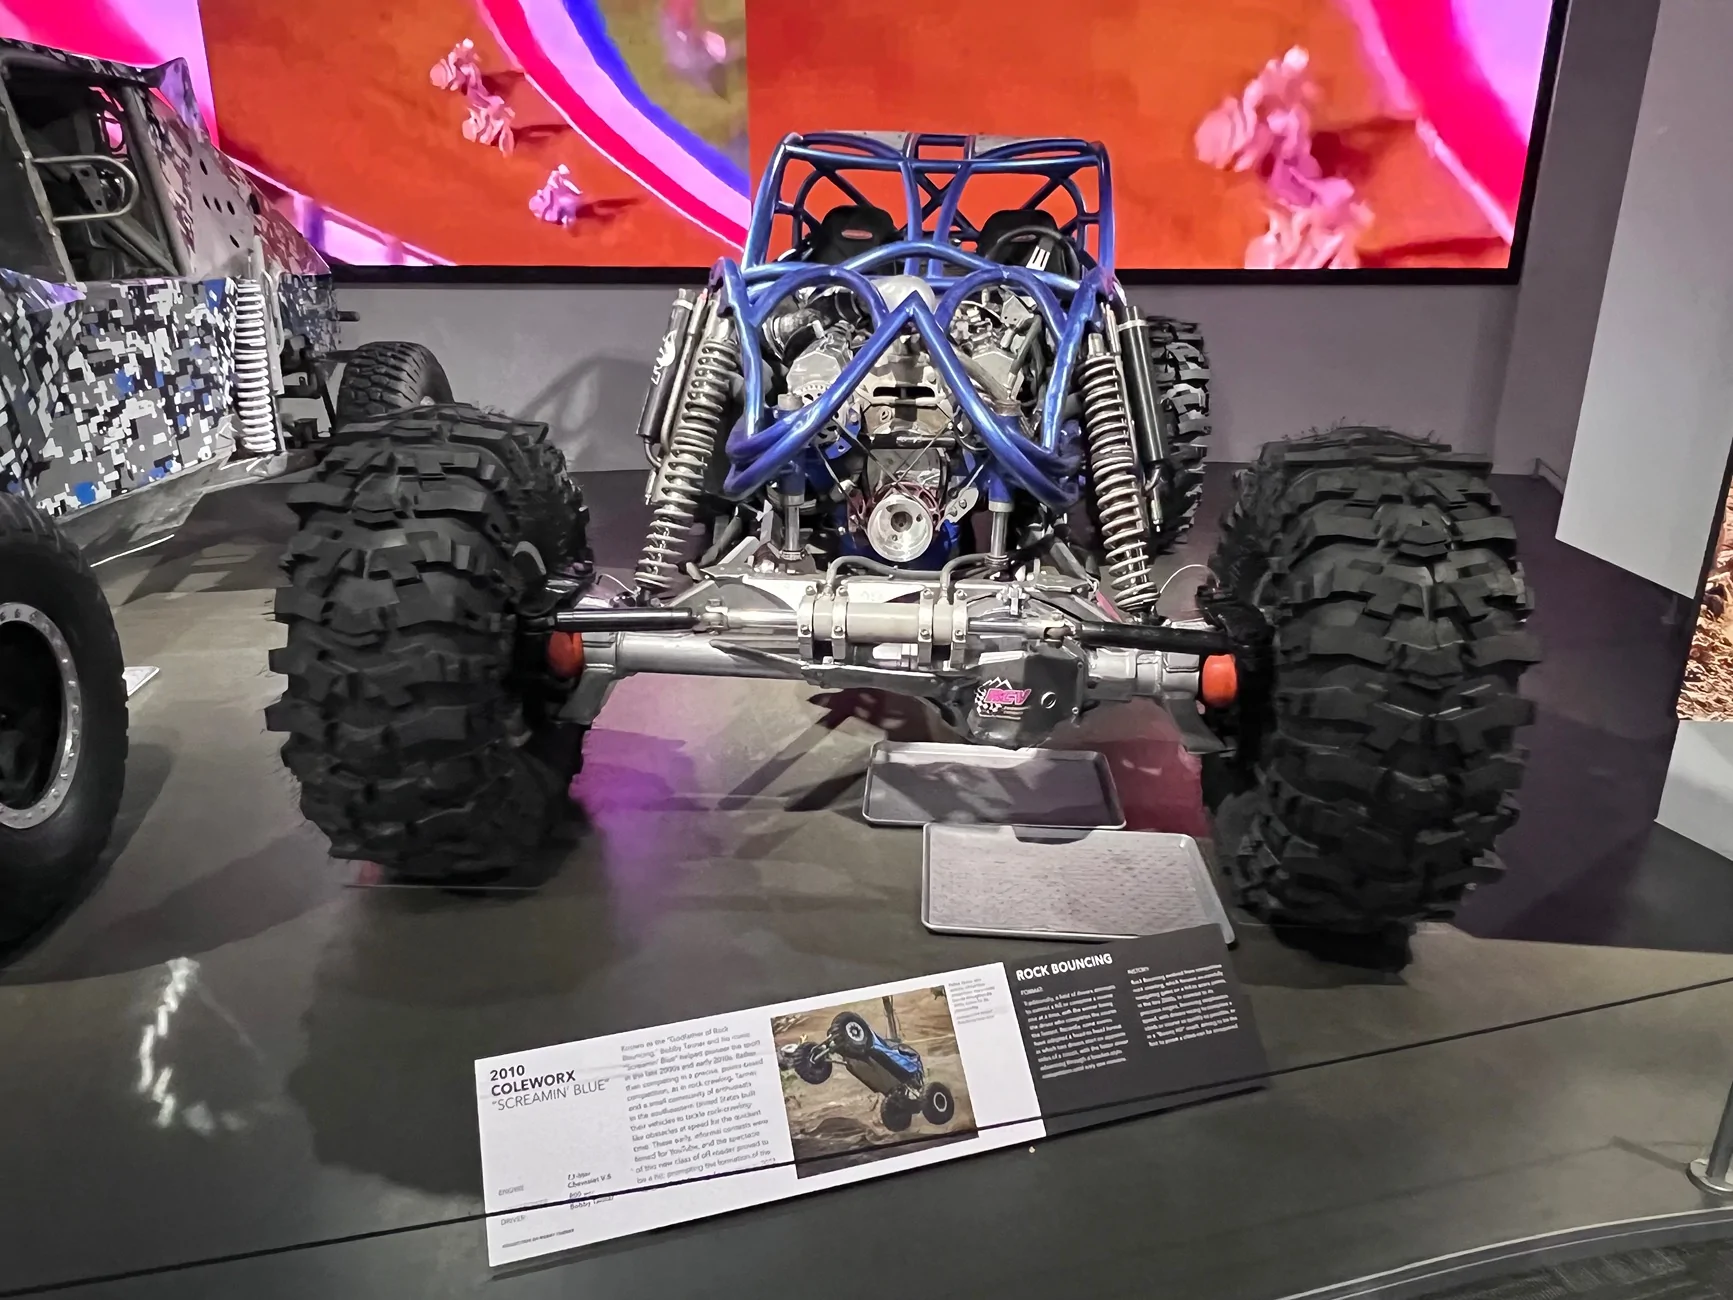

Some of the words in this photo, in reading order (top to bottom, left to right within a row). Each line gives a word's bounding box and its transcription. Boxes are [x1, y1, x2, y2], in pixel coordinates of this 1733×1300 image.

[1015, 964, 1049, 981] ROCK
[1051, 953, 1112, 975] BOUNCING
[489, 1064, 524, 1081] 2010
[490, 1069, 575, 1097] COLEWORX
